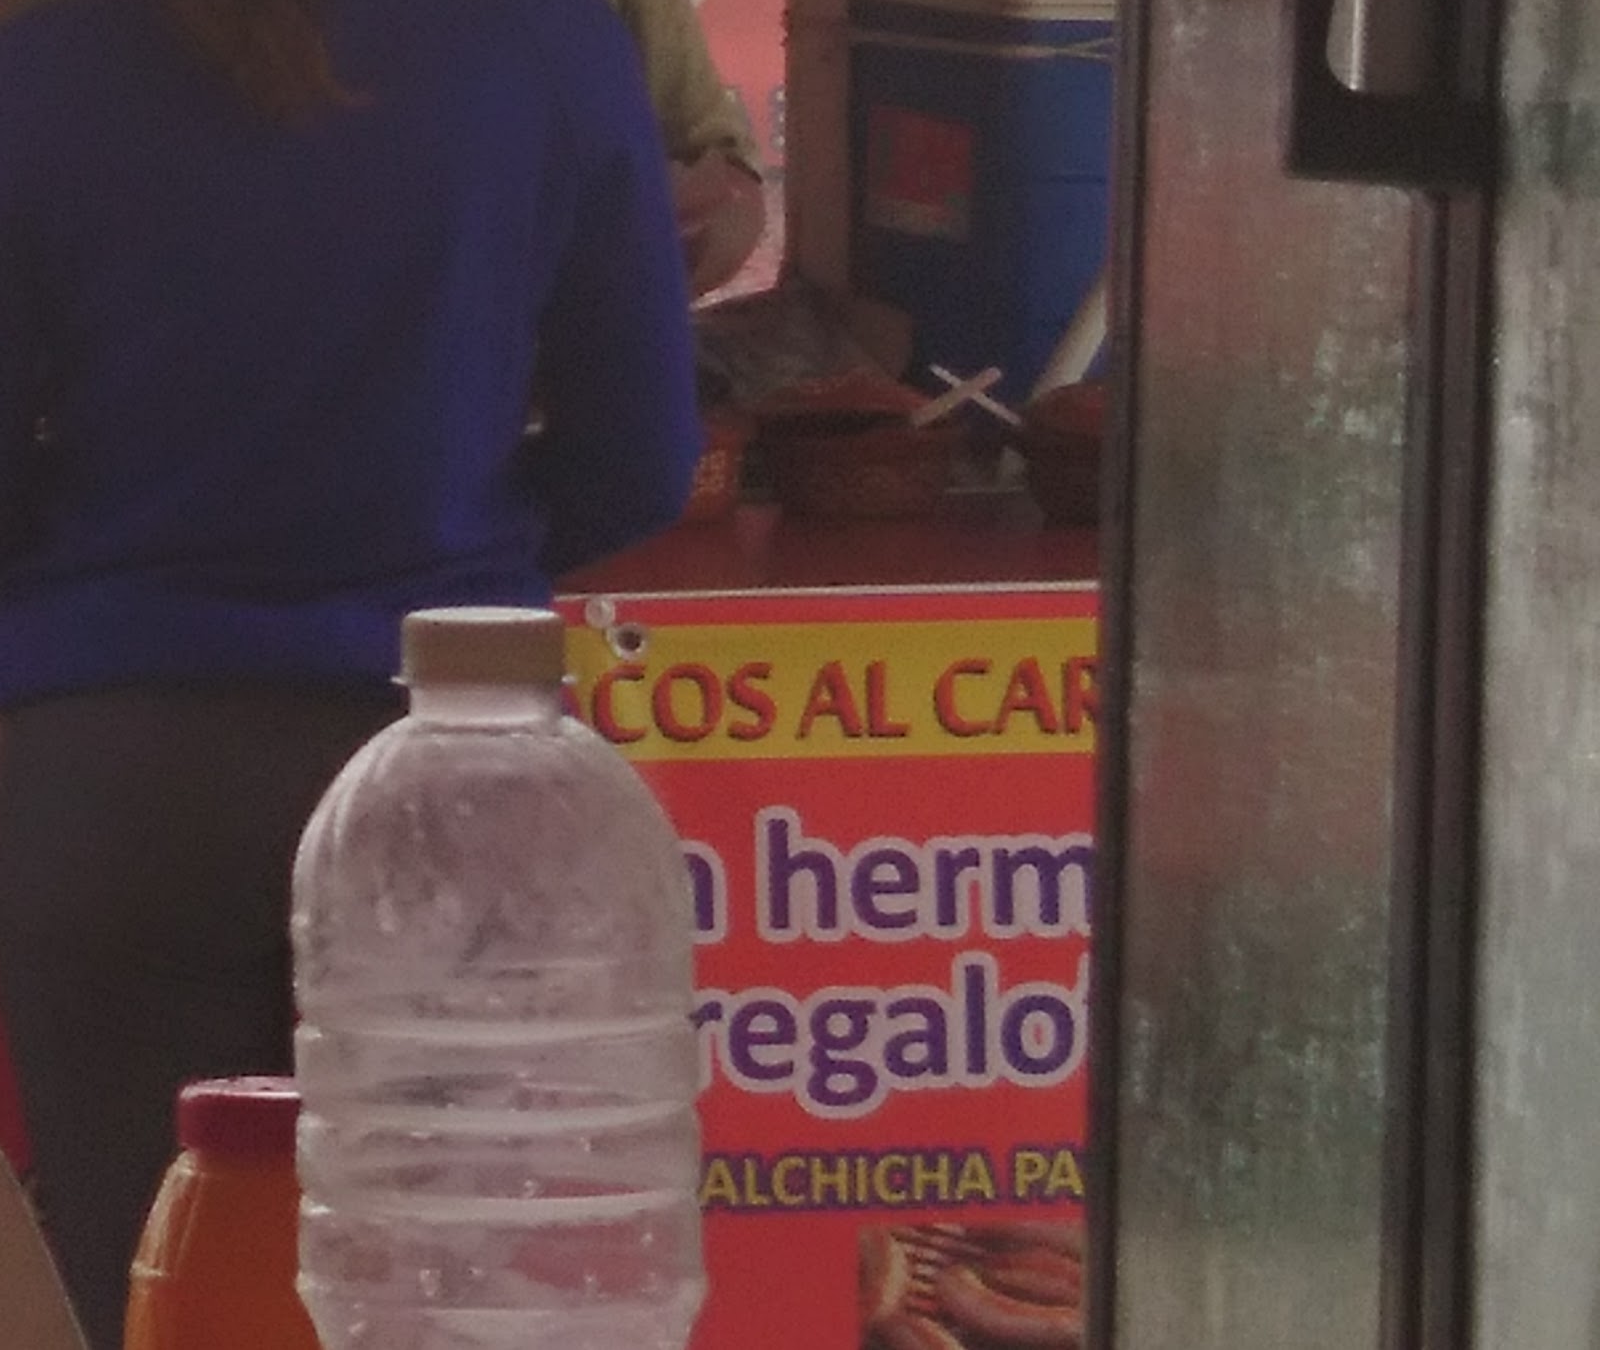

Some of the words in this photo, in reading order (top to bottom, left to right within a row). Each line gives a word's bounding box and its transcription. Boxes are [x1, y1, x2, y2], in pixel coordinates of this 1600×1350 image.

[562, 660, 777, 744] COS
[795, 659, 910, 739] AL
[934, 656, 1101, 737] CAR
[767, 816, 1094, 932] herm
[690, 963, 1085, 1107] regalo
[701, 1153, 994, 1207] ALCHICHA
[1014, 1149, 1085, 1197] PA
